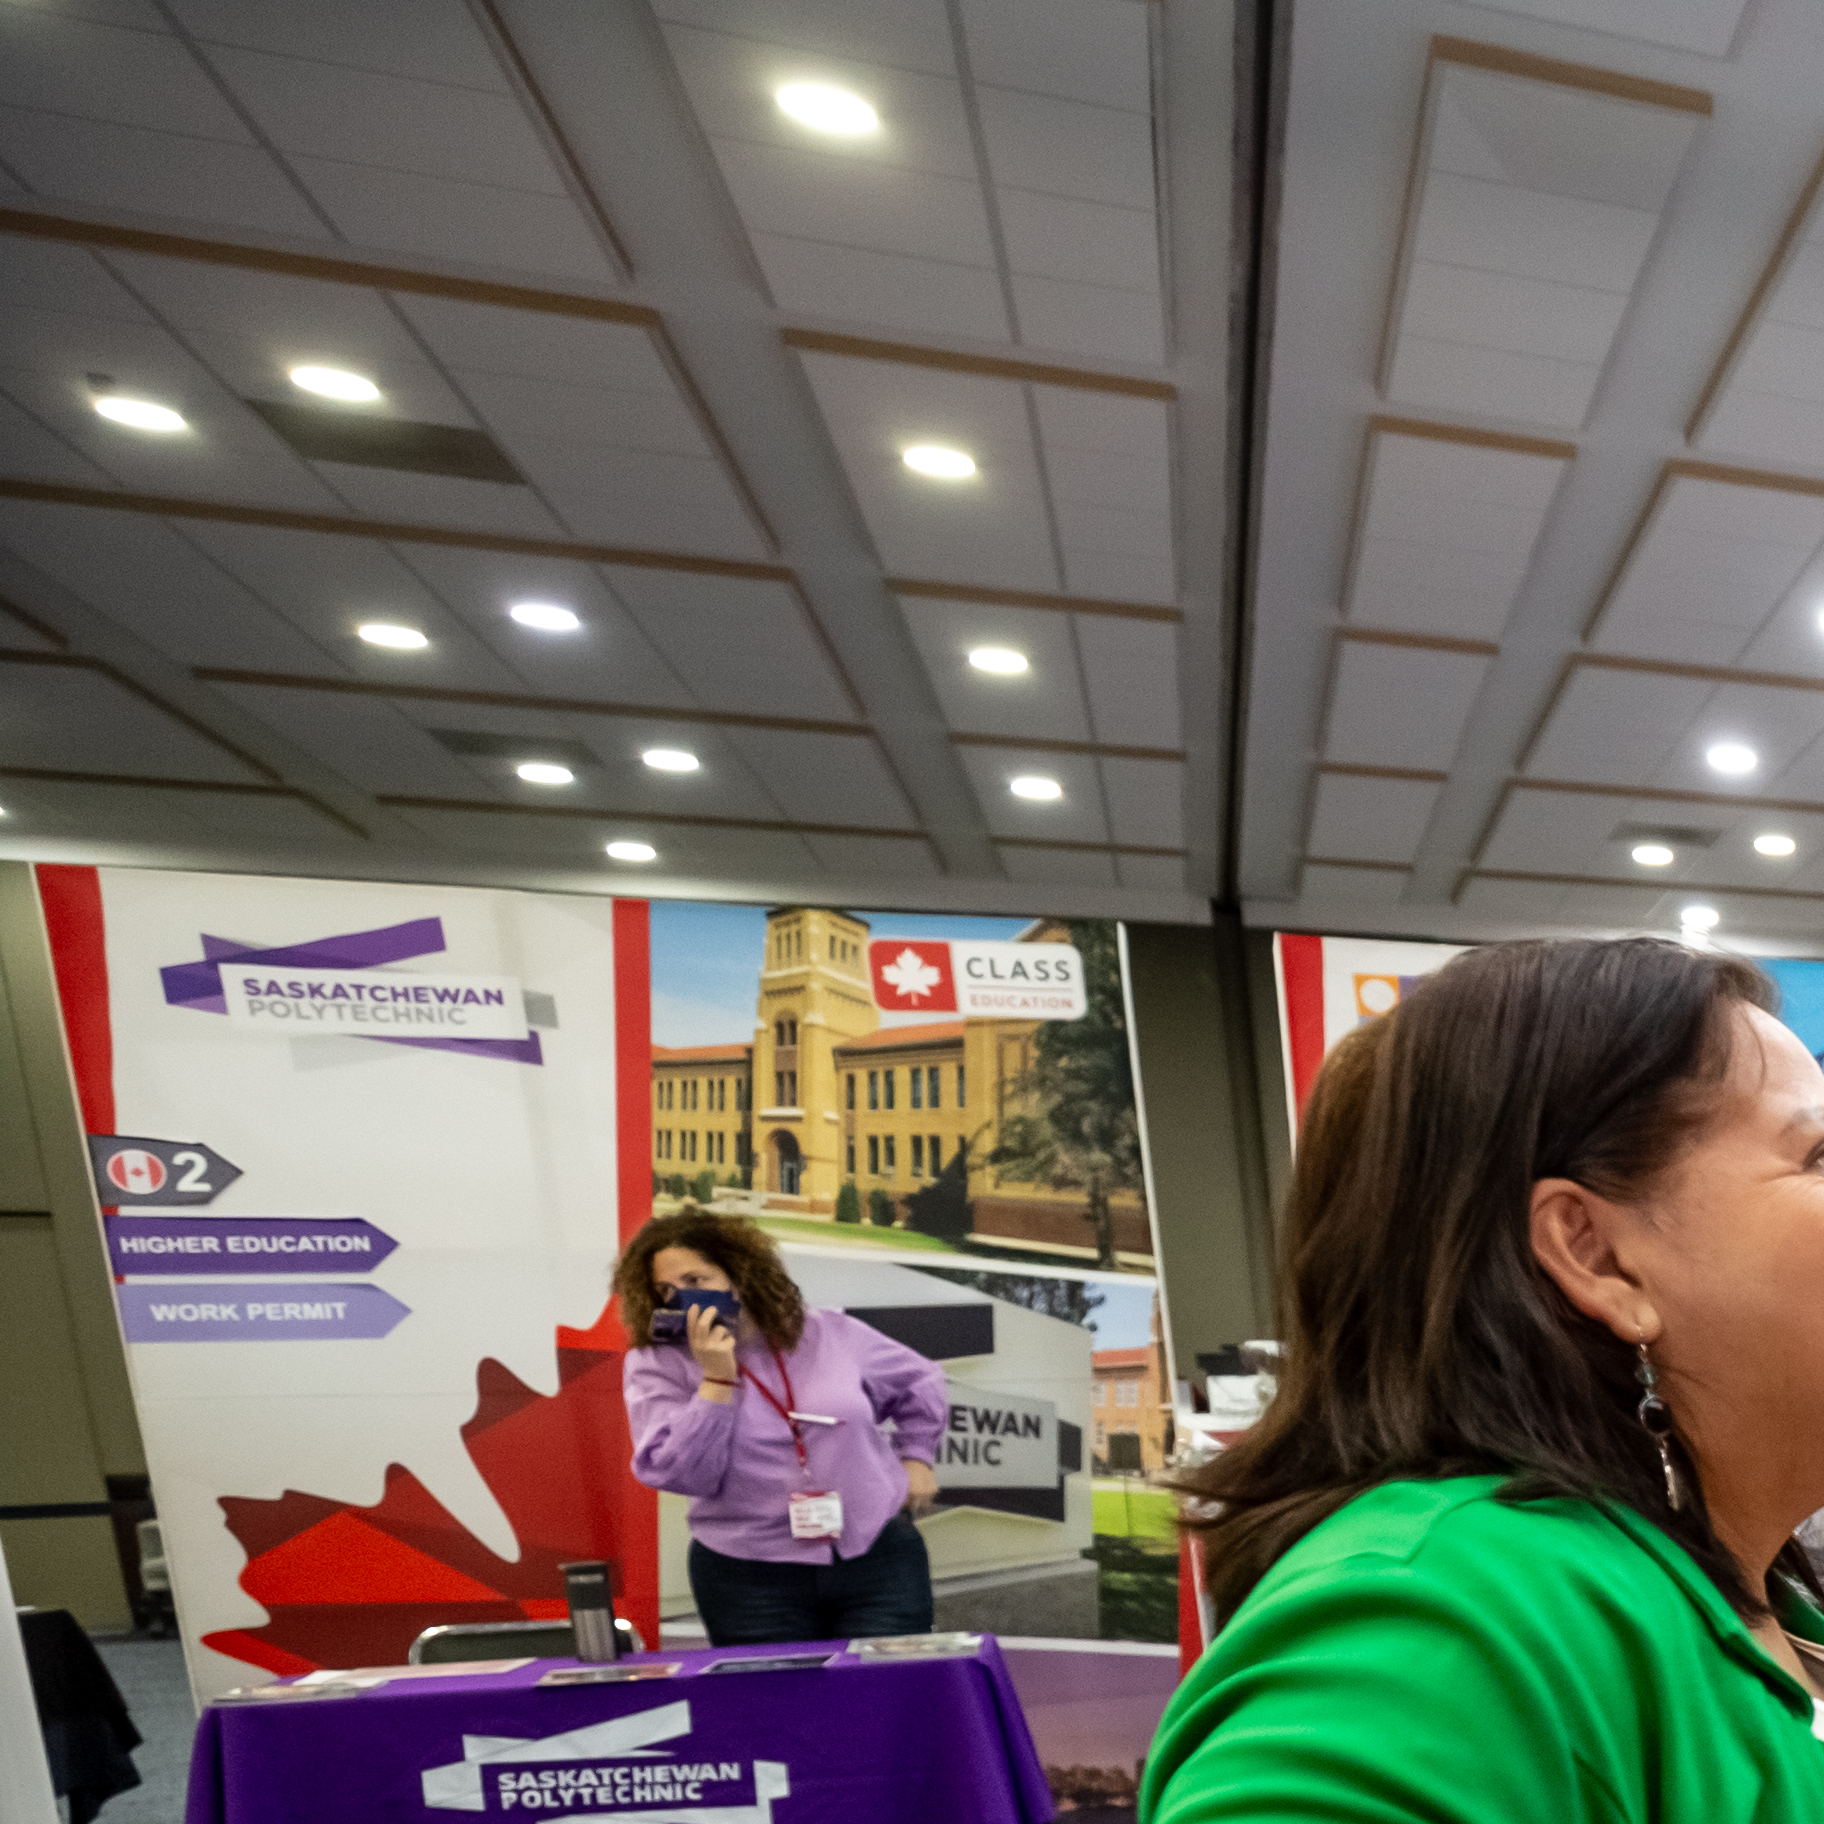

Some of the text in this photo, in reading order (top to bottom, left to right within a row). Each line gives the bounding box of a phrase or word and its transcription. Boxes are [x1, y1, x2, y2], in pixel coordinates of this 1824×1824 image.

[965, 957, 1072, 983] CLASS
[243, 977, 504, 1007] SASKATCHEWAN
[969, 993, 1074, 1011] EDUCATION
[249, 999, 467, 1026] POLYTECHNIC
[172, 1151, 212, 1193] 2
[120, 1235, 372, 1255] HIGHER EDUCATION
[150, 1302, 348, 1322] WORK PERMIT
[950, 1404, 1042, 1438] EWAN
[498, 1762, 741, 1792] SASKATCHEWAN
[499, 1781, 703, 1811] POLYTECHNIC
